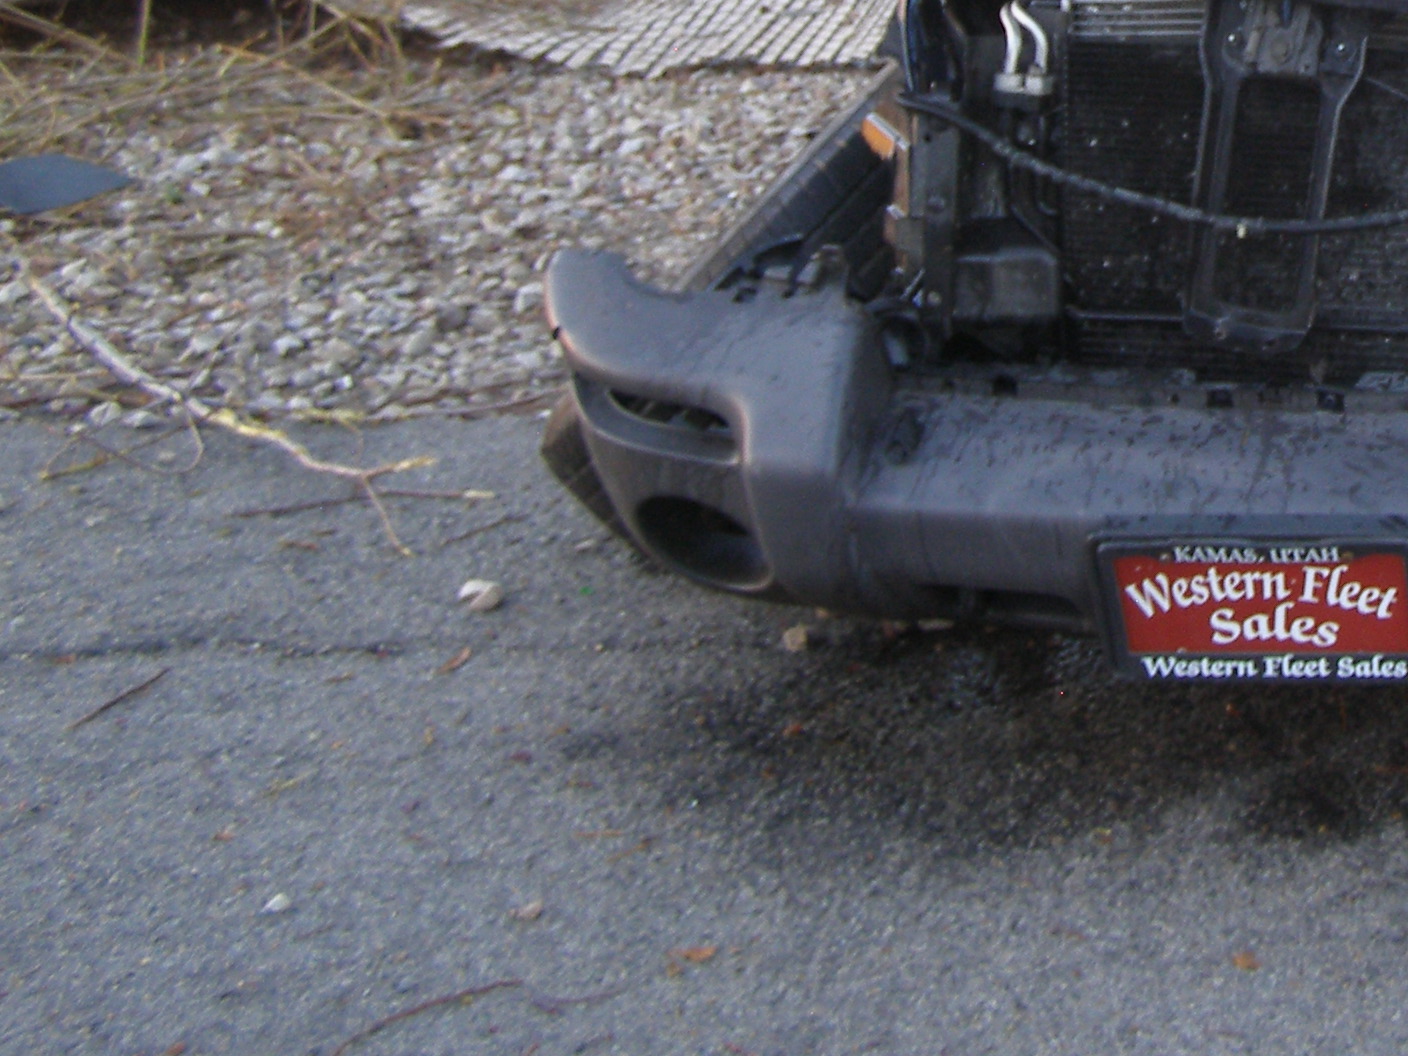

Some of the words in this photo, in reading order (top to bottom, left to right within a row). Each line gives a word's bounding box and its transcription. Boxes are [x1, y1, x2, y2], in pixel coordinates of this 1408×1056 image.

[1125, 566, 1292, 619] Western
[1299, 564, 1397, 620] Fleet
[1210, 601, 1341, 648] Sales
[1143, 655, 1258, 679] Western
[1263, 654, 1332, 679] Fleet
[1336, 656, 1408, 679] Sales
